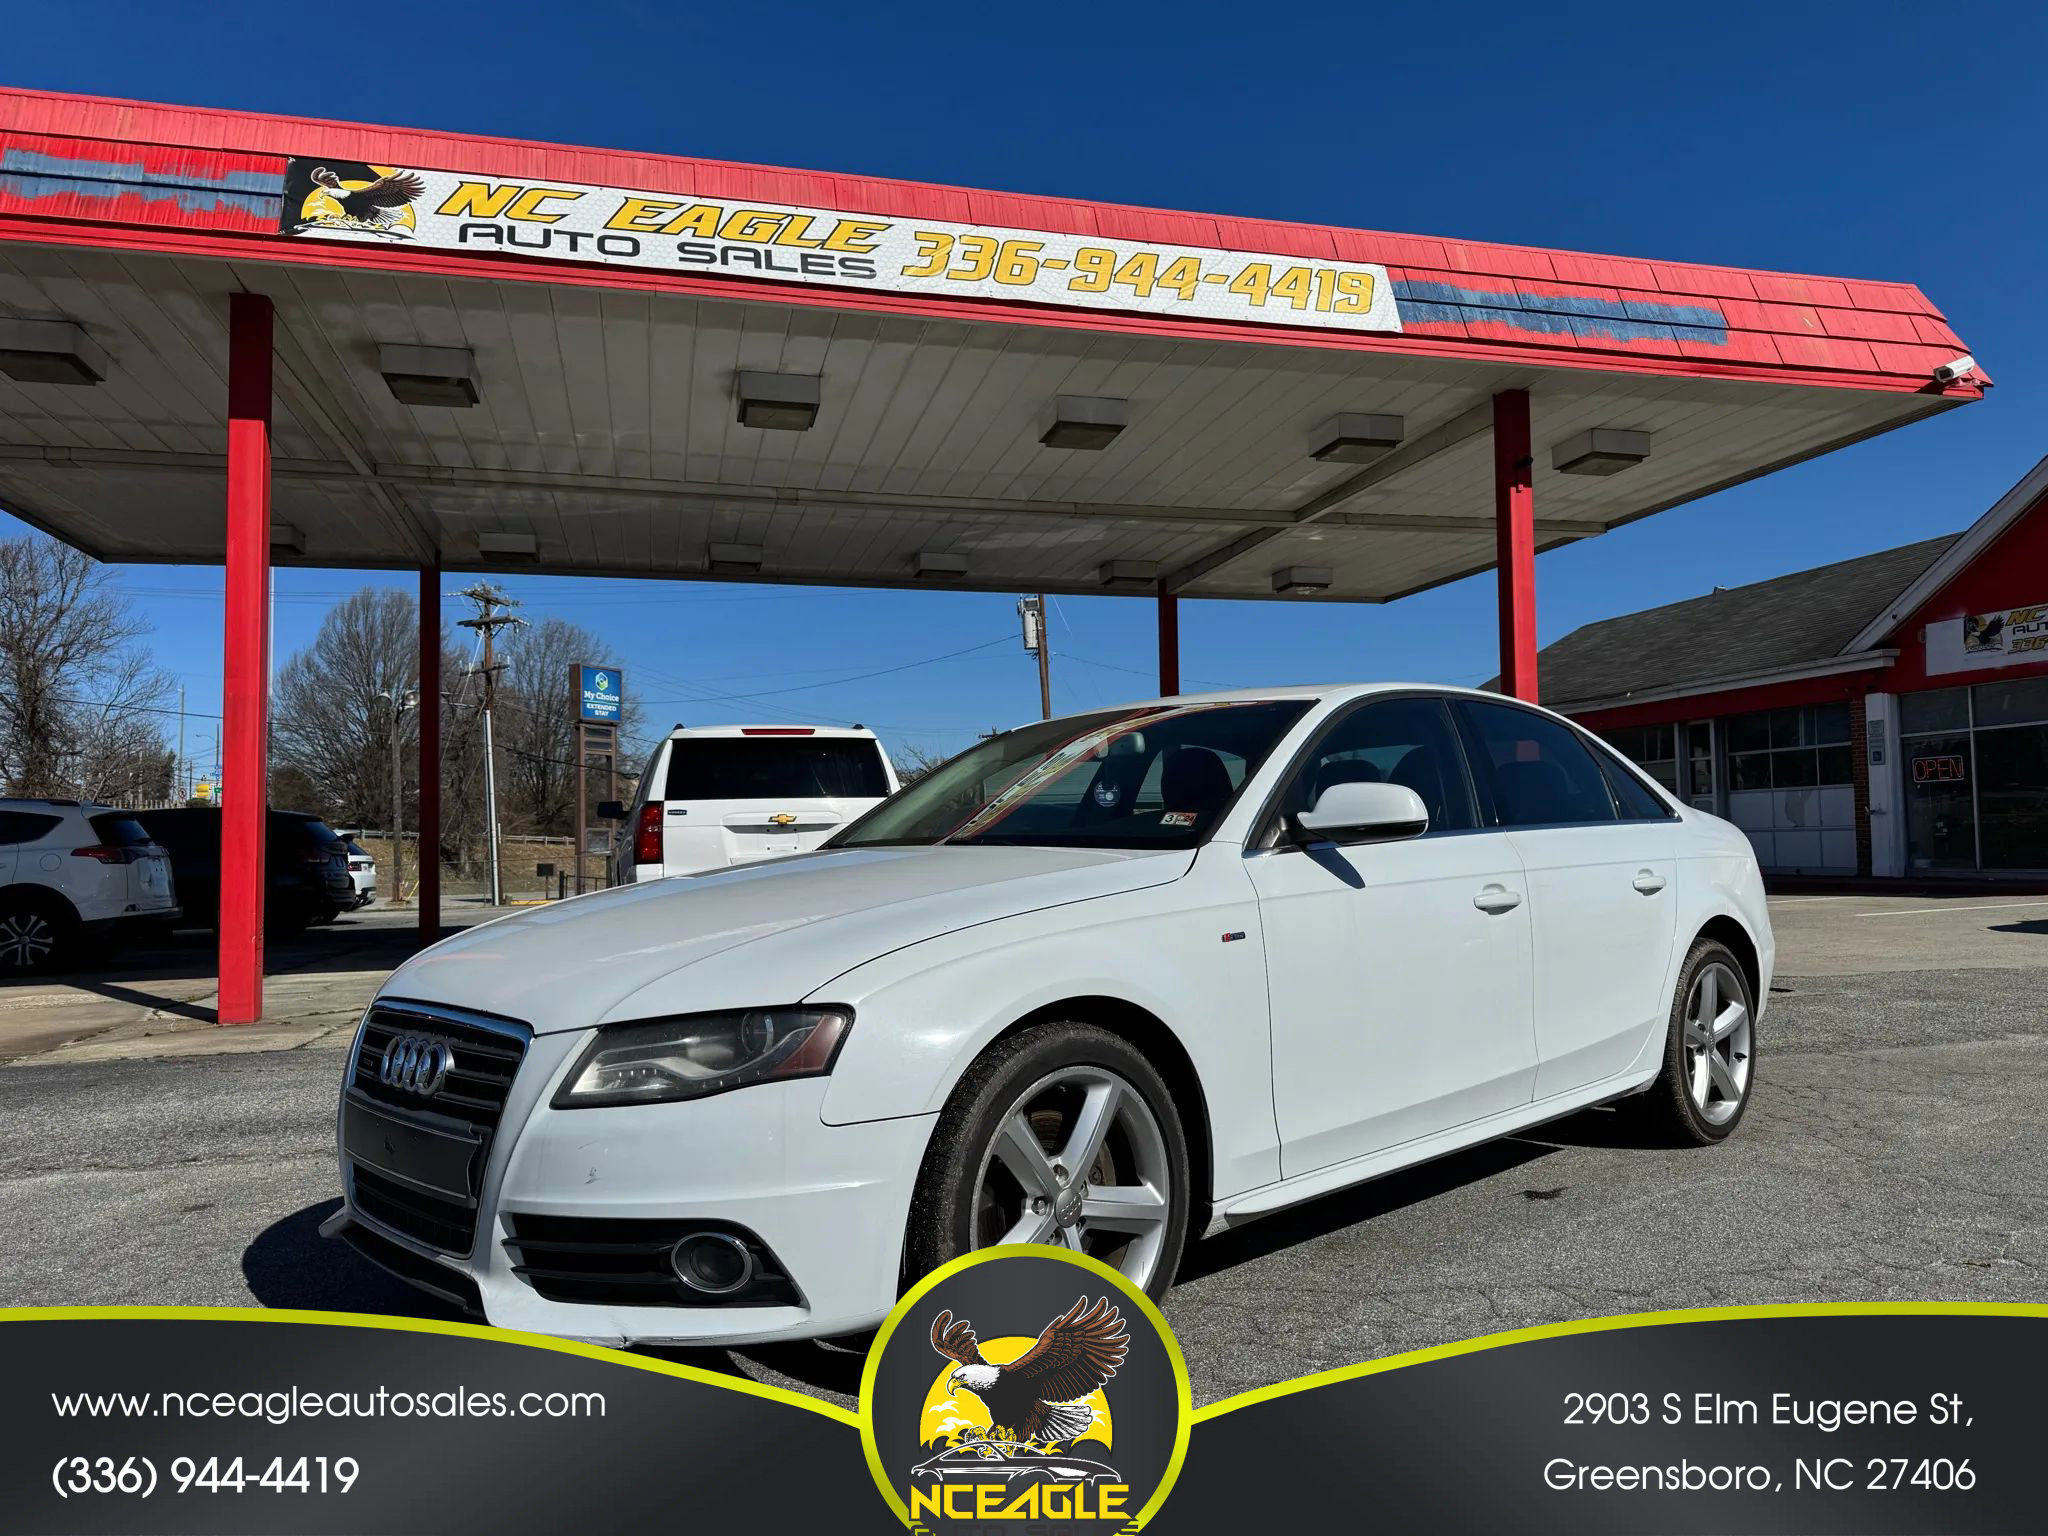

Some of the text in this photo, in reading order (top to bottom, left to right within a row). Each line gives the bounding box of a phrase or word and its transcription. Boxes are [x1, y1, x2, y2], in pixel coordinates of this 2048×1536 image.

[435, 181, 897, 254] NC EAGLE
[458, 222, 878, 280] AUTO SALES
[900, 230, 1375, 315] 336-944-4419
[2006, 606, 2048, 626] NC
[584, 690, 619, 701] My Choice
[586, 703, 616, 711] EXTENDED
[1914, 758, 1963, 780] OPEN
